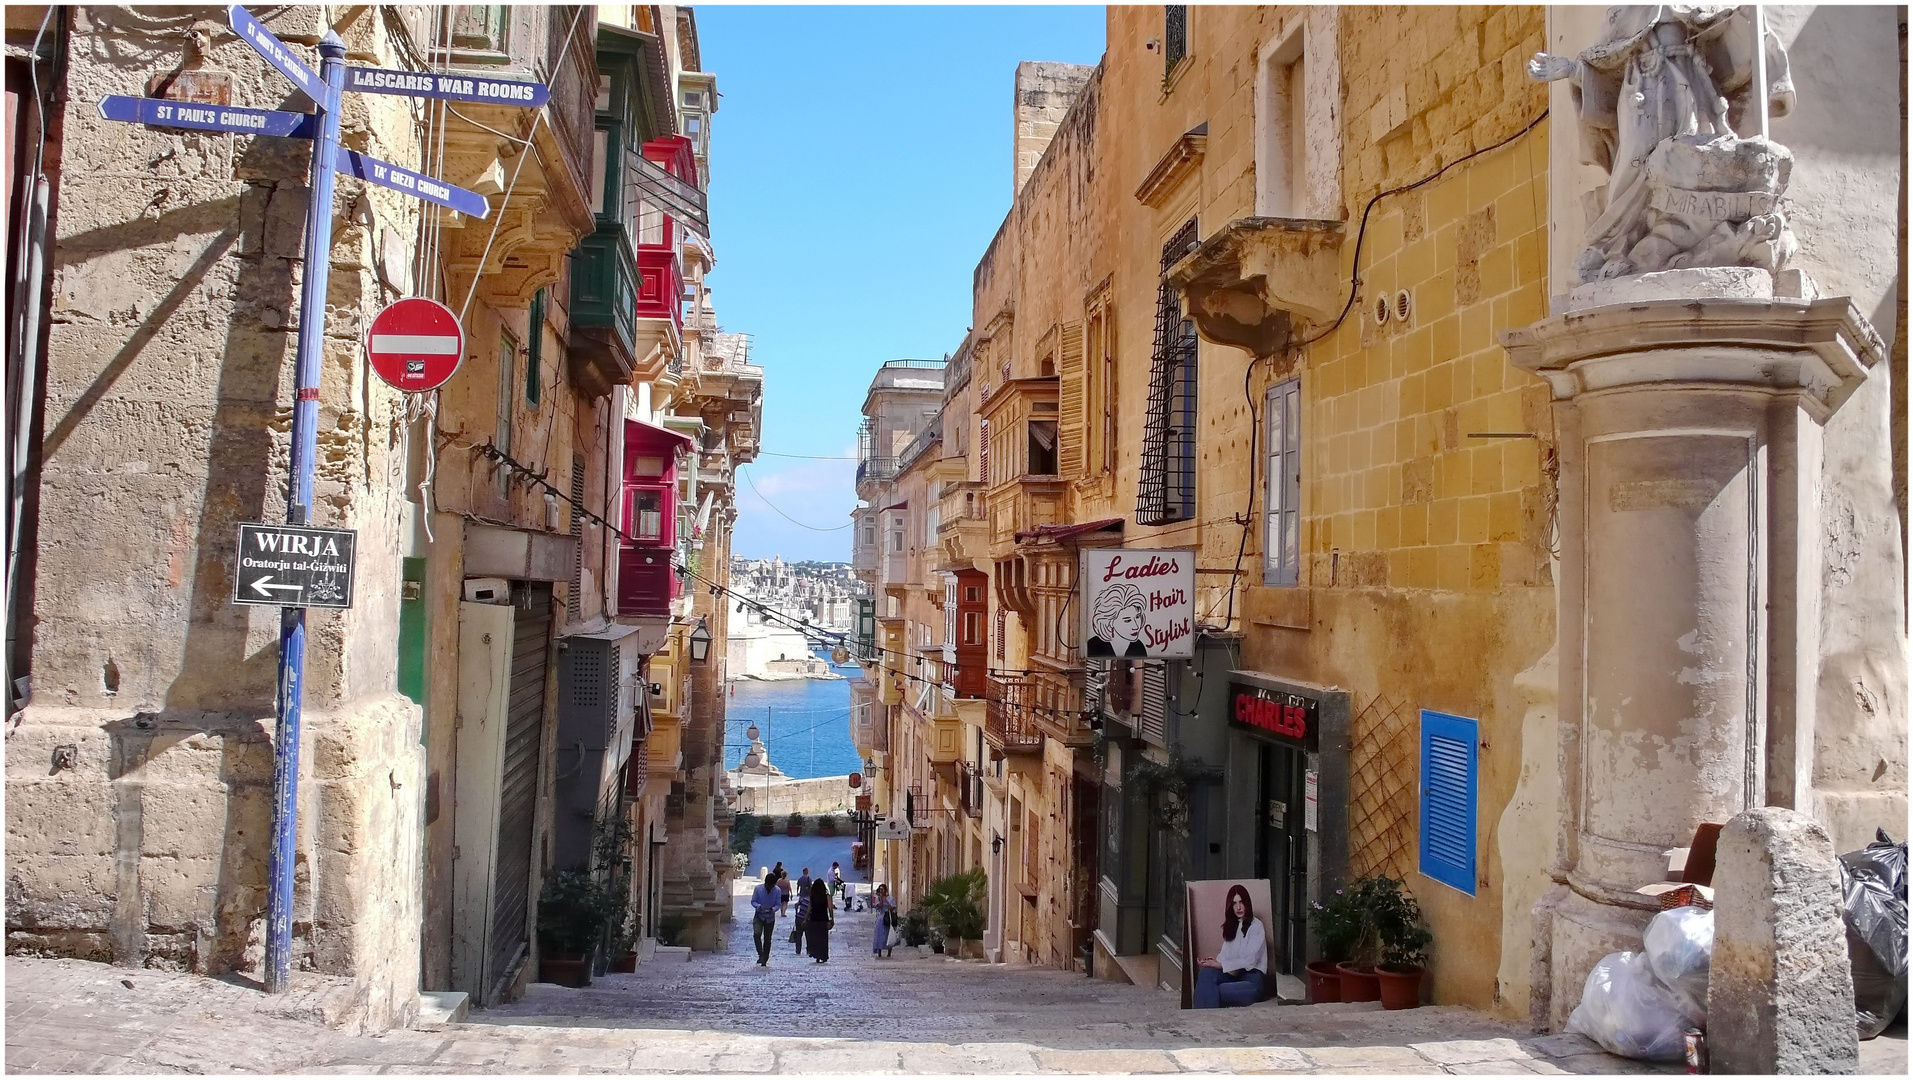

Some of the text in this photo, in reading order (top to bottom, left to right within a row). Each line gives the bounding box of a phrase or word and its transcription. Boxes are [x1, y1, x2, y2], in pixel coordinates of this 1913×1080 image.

[247, 22, 256, 37] ST
[256, 31, 275, 55] JOHN'S
[353, 71, 534, 101] LASCARIS WAR ROOMS
[157, 106, 266, 129] ST PAUL'S CHURCH
[374, 164, 450, 201] TA' GIEZU CHURCH
[255, 532, 340, 557] WIRJA
[243, 557, 290, 571] Oratorju
[1103, 555, 1179, 582] Ladies
[1149, 588, 1187, 612] Hair
[1144, 617, 1190, 652] Stylist
[1236, 693, 1306, 739] CHARLES
